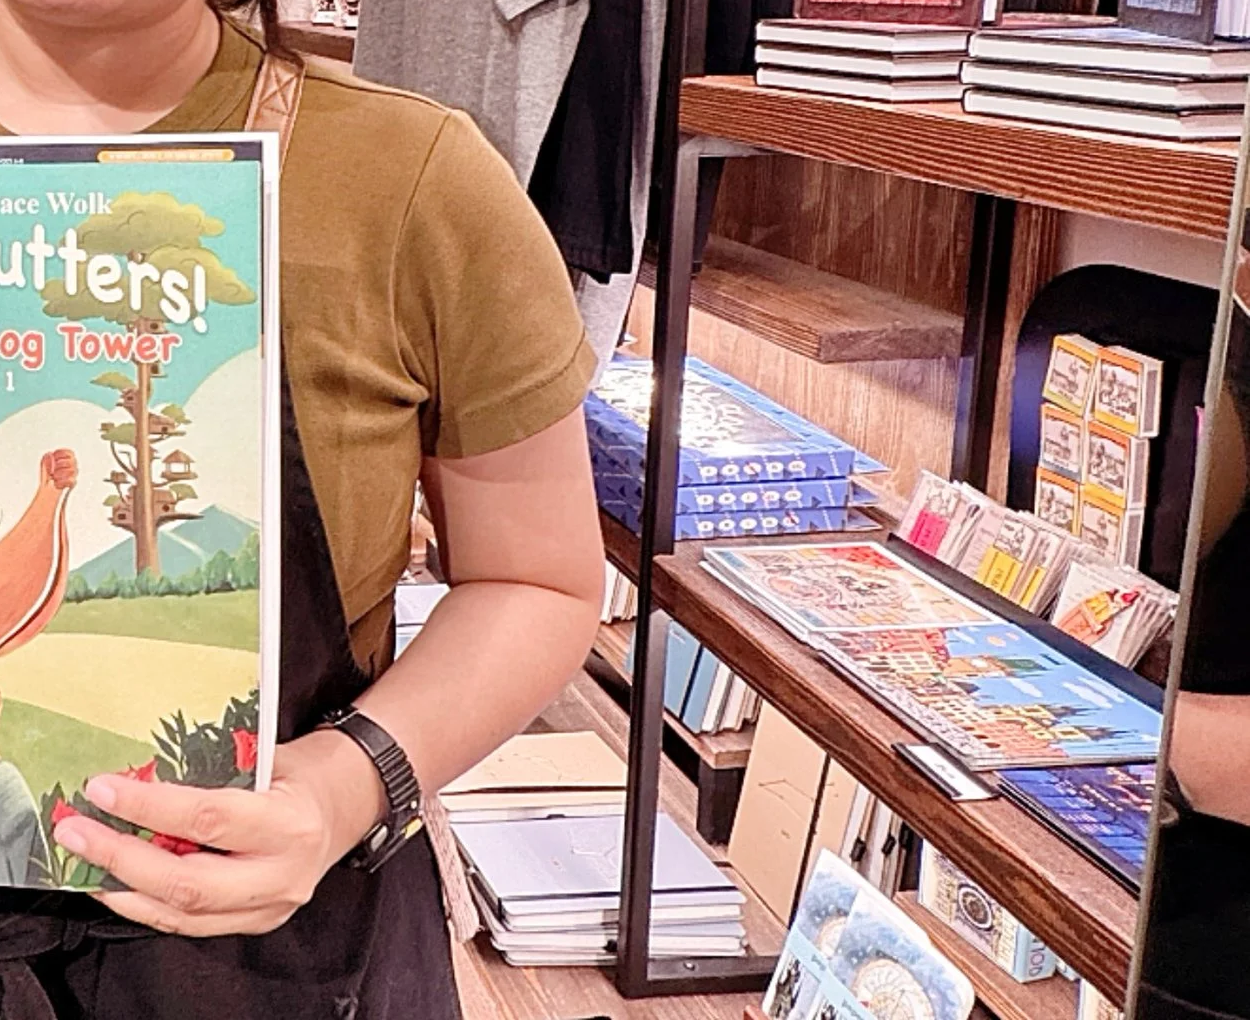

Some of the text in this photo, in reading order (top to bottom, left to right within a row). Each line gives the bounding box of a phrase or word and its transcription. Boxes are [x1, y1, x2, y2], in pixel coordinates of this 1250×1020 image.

[45, 191, 113, 215] Wolk
[58, 323, 181, 364] Tower
[5, 371, 16, 392] 1
